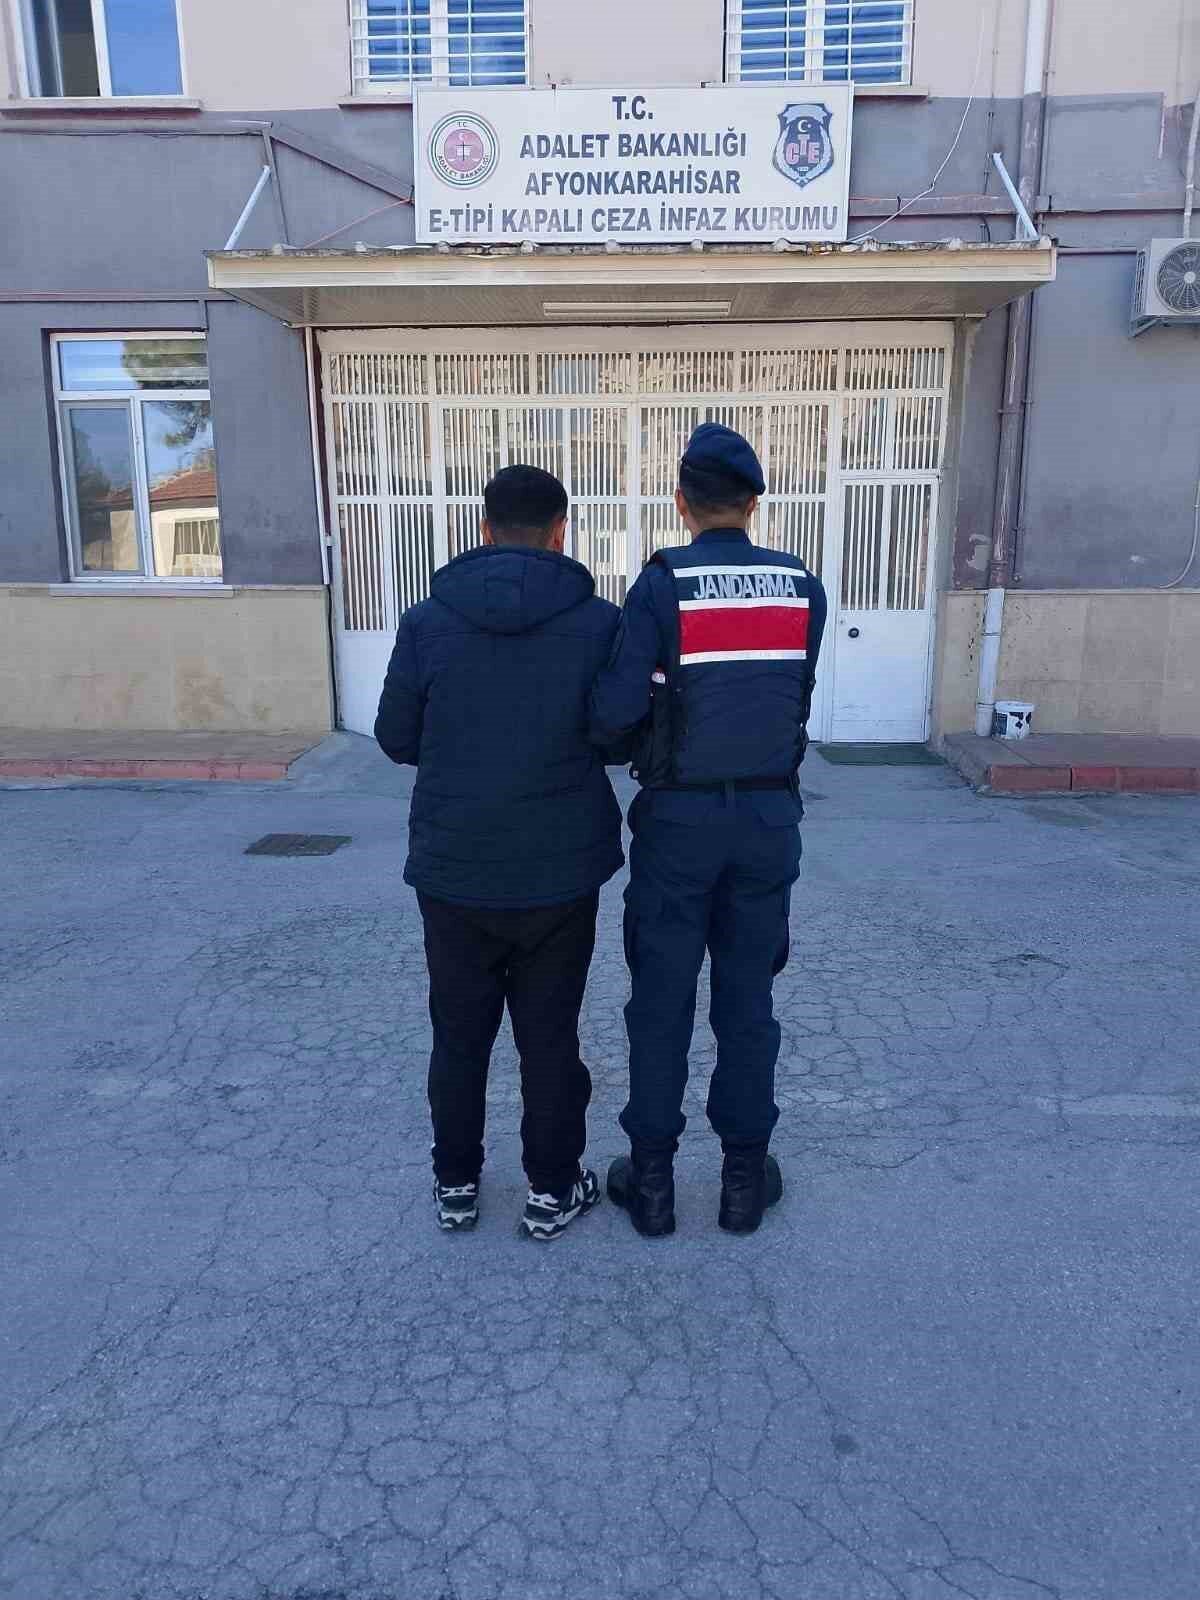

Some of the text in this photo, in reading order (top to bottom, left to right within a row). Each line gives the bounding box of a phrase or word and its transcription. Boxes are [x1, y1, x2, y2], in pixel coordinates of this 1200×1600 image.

[612, 96, 653, 120] T.C.
[520, 127, 746, 158] ADALET BAKANLIĞI
[525, 164, 741, 195] AFYONKARAHİSAR
[429, 202, 838, 233] E-TİPİ KAPALI CEZA İNFAZ KURUMU
[693, 574, 798, 600] JANDARMA
